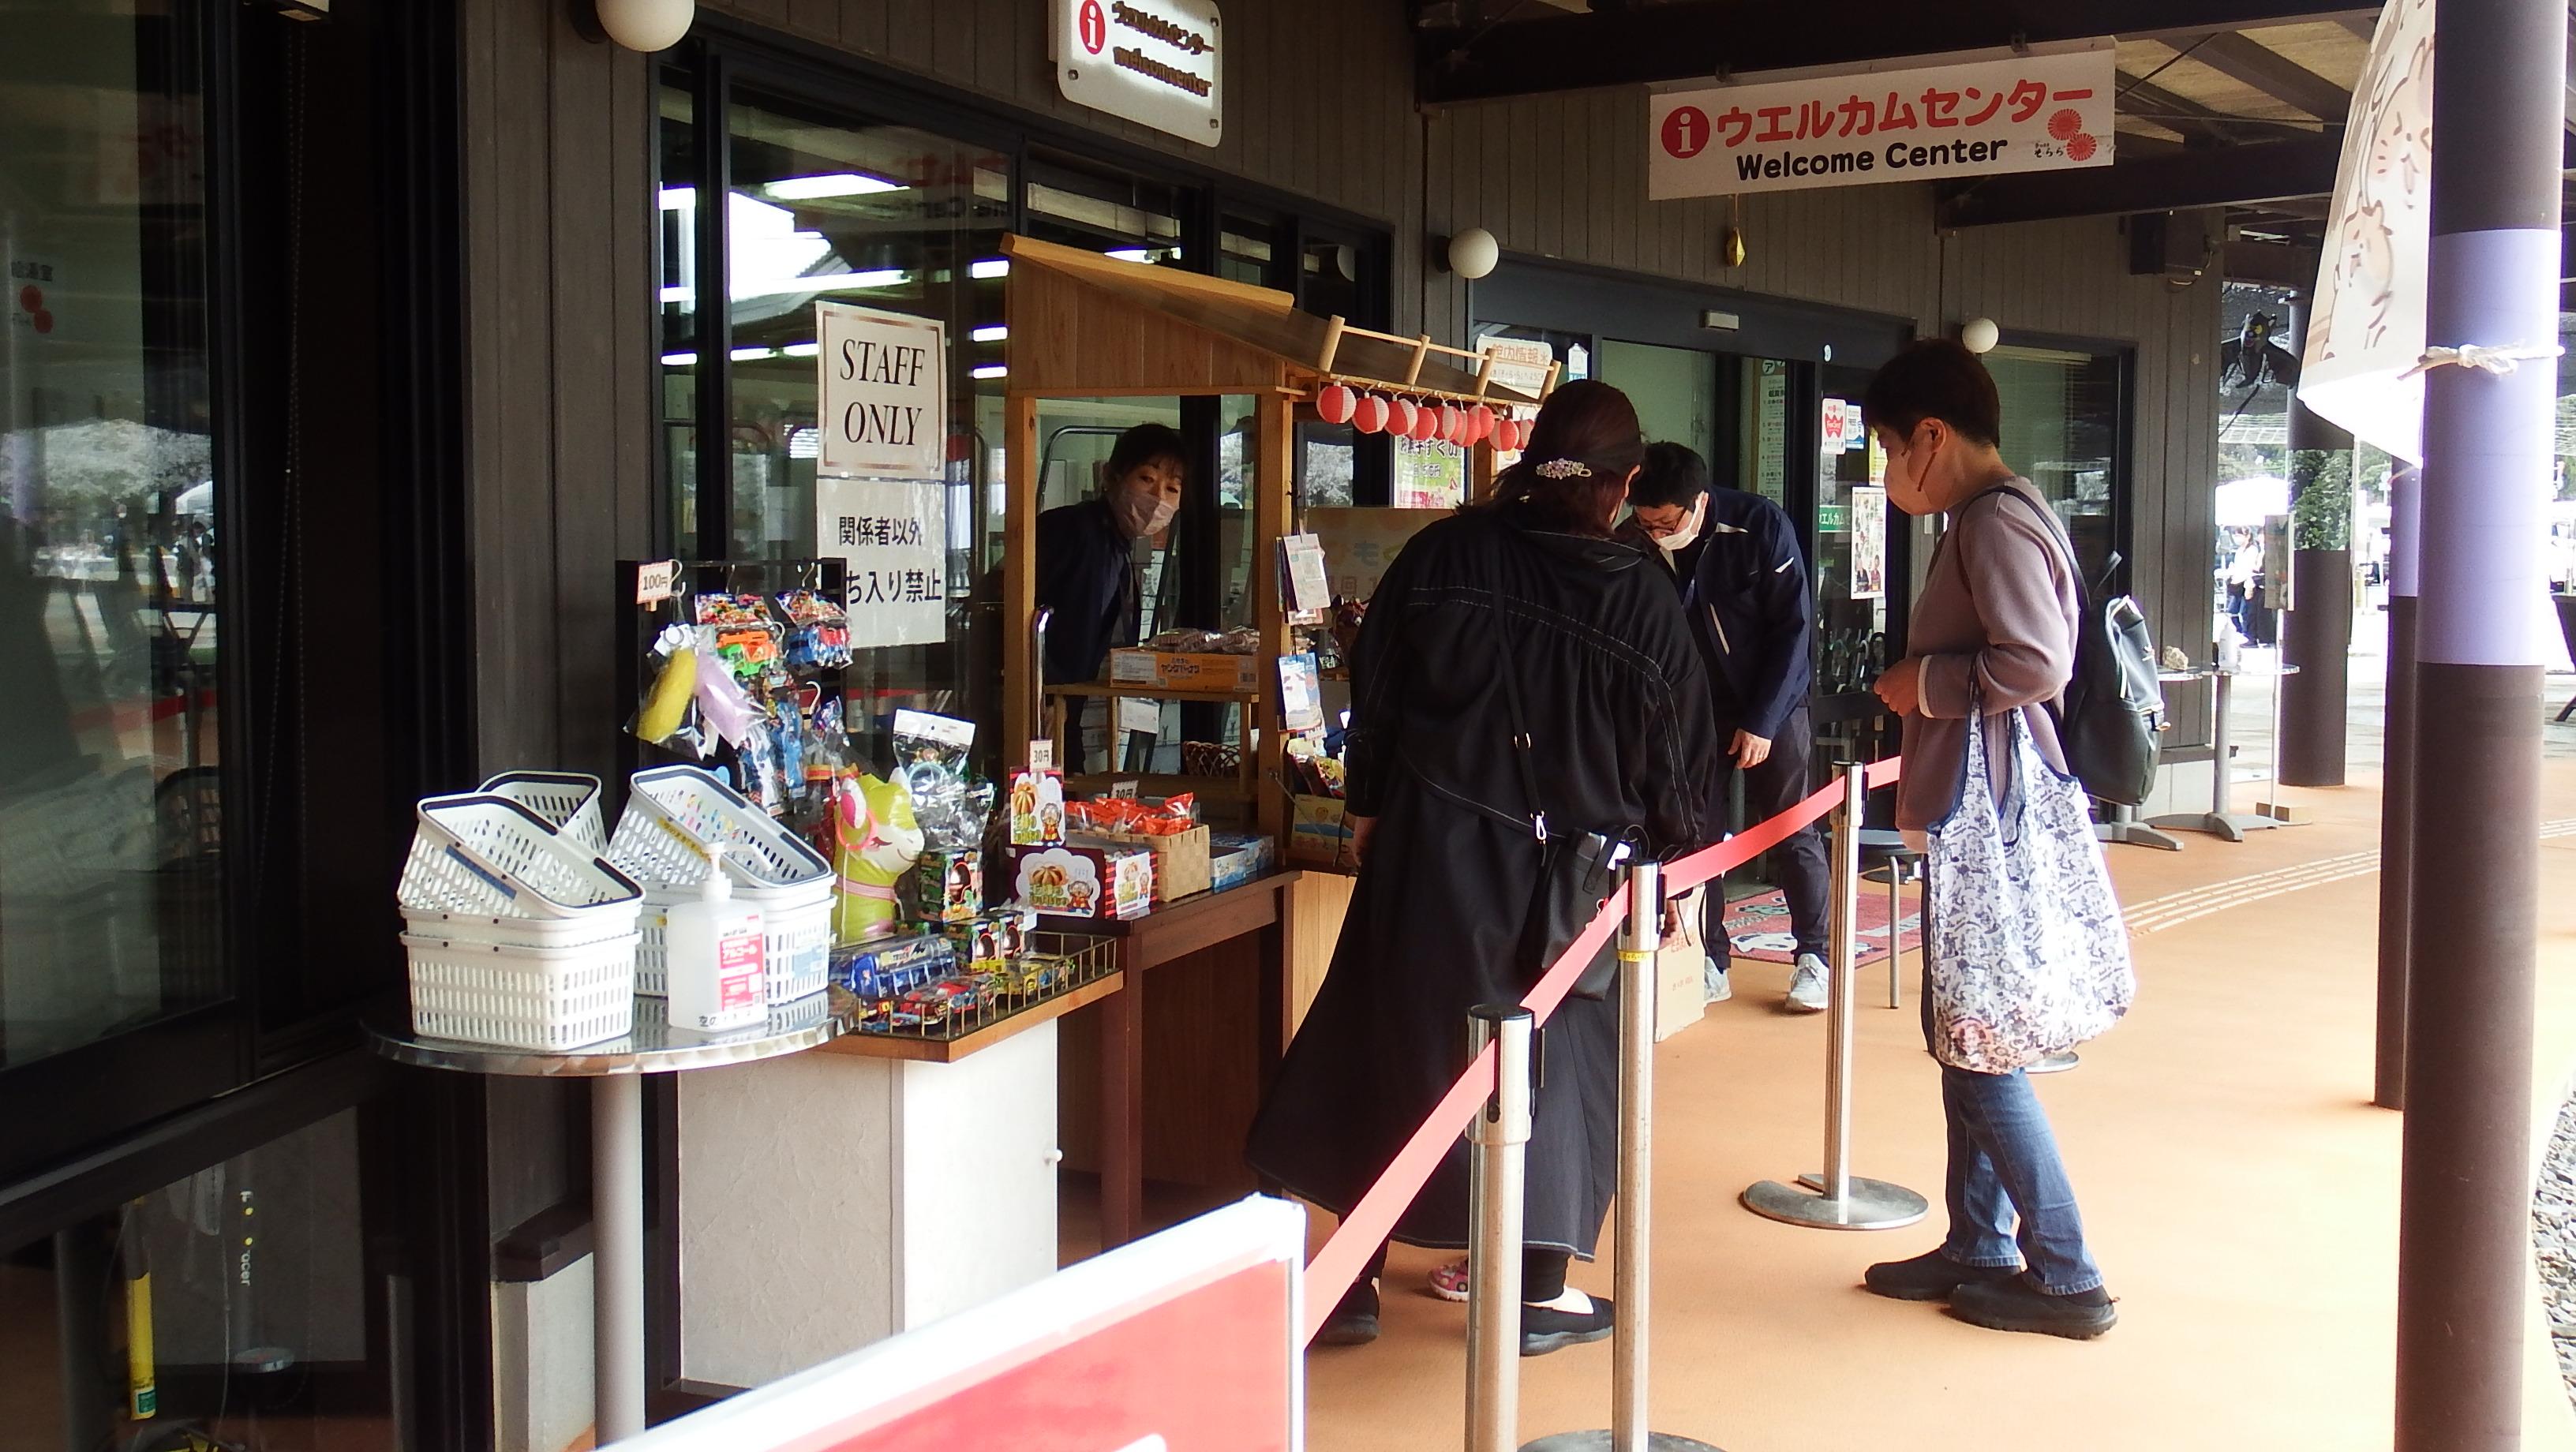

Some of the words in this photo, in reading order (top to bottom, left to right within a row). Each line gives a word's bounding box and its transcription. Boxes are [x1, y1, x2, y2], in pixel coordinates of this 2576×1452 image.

[1717, 79, 2093, 148] ウエルカムセンター
[1736, 149, 1875, 182] Welcome
[1885, 137, 2008, 169] Center
[840, 339, 925, 386] STAFF
[844, 402, 923, 446] ONLY
[839, 516, 923, 546] 関係者以外
[642, 574, 668, 590] 100円
[847, 568, 942, 604] ち入り禁止
[1033, 749, 1050, 763] 30円
